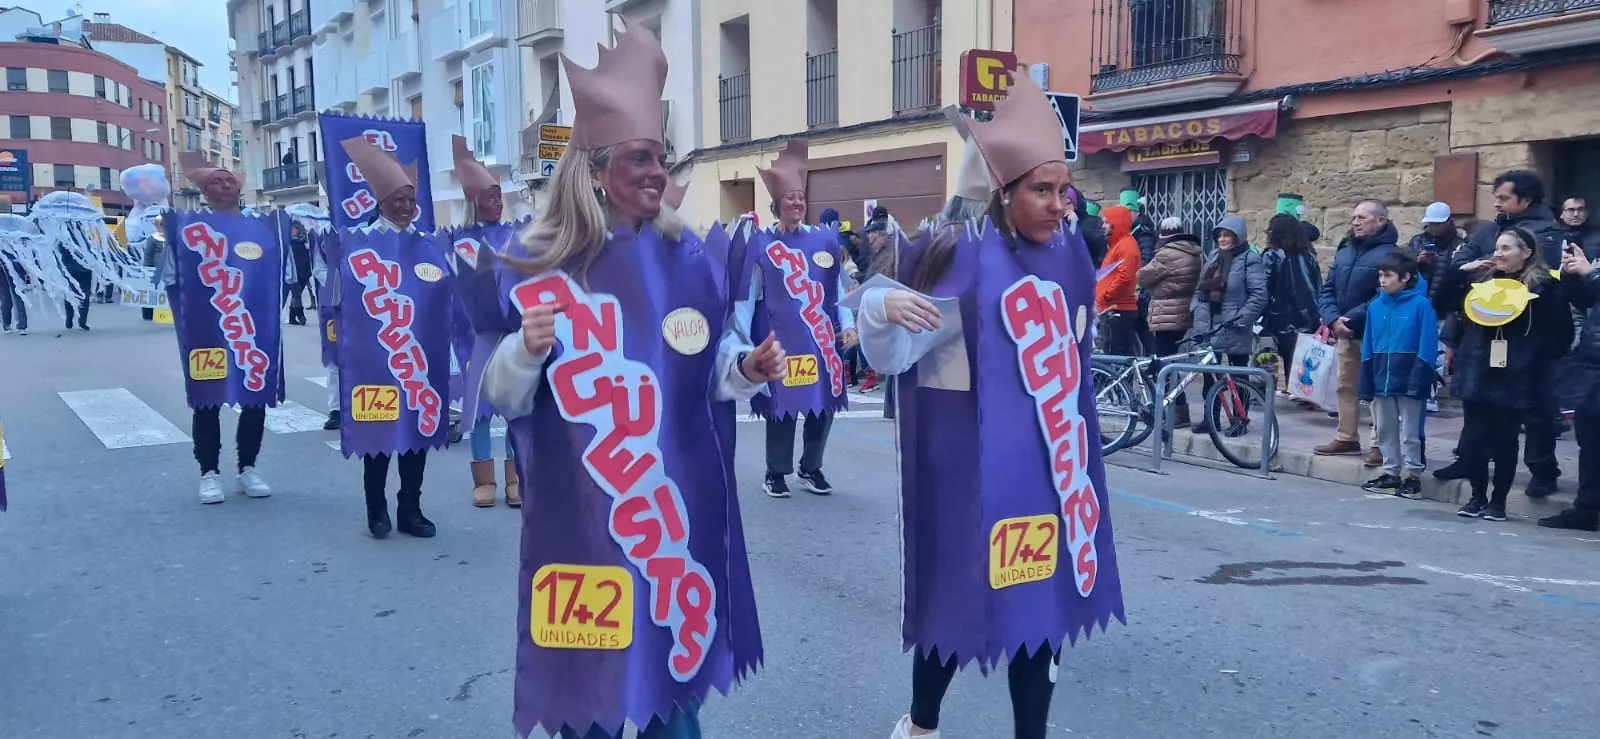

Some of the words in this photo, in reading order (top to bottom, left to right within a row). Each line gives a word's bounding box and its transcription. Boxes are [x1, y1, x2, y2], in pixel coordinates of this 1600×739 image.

[972, 93, 1010, 102] TABACO
[1104, 118, 1221, 145] TABACOS
[344, 190, 375, 217] DE
[184, 223, 269, 390] ANGÜESITOS
[768, 242, 843, 395] ANGÜESITOS
[350, 251, 439, 434] ANGÜESITOS
[663, 319, 706, 342] VALOR
[191, 350, 226, 371] 17+2
[787, 357, 817, 378] 17+2
[353, 387, 398, 411] 17+2
[356, 411, 395, 419] UNIDADES
[1005, 280, 1100, 593] ANGÜESITOS
[514, 279, 712, 674] ANGÜESITOS
[992, 521, 1056, 569] 17+2
[995, 564, 1053, 586] UNIDADES
[535, 570, 622, 629] 17+2
[540, 627, 620, 647] UNIDADES
